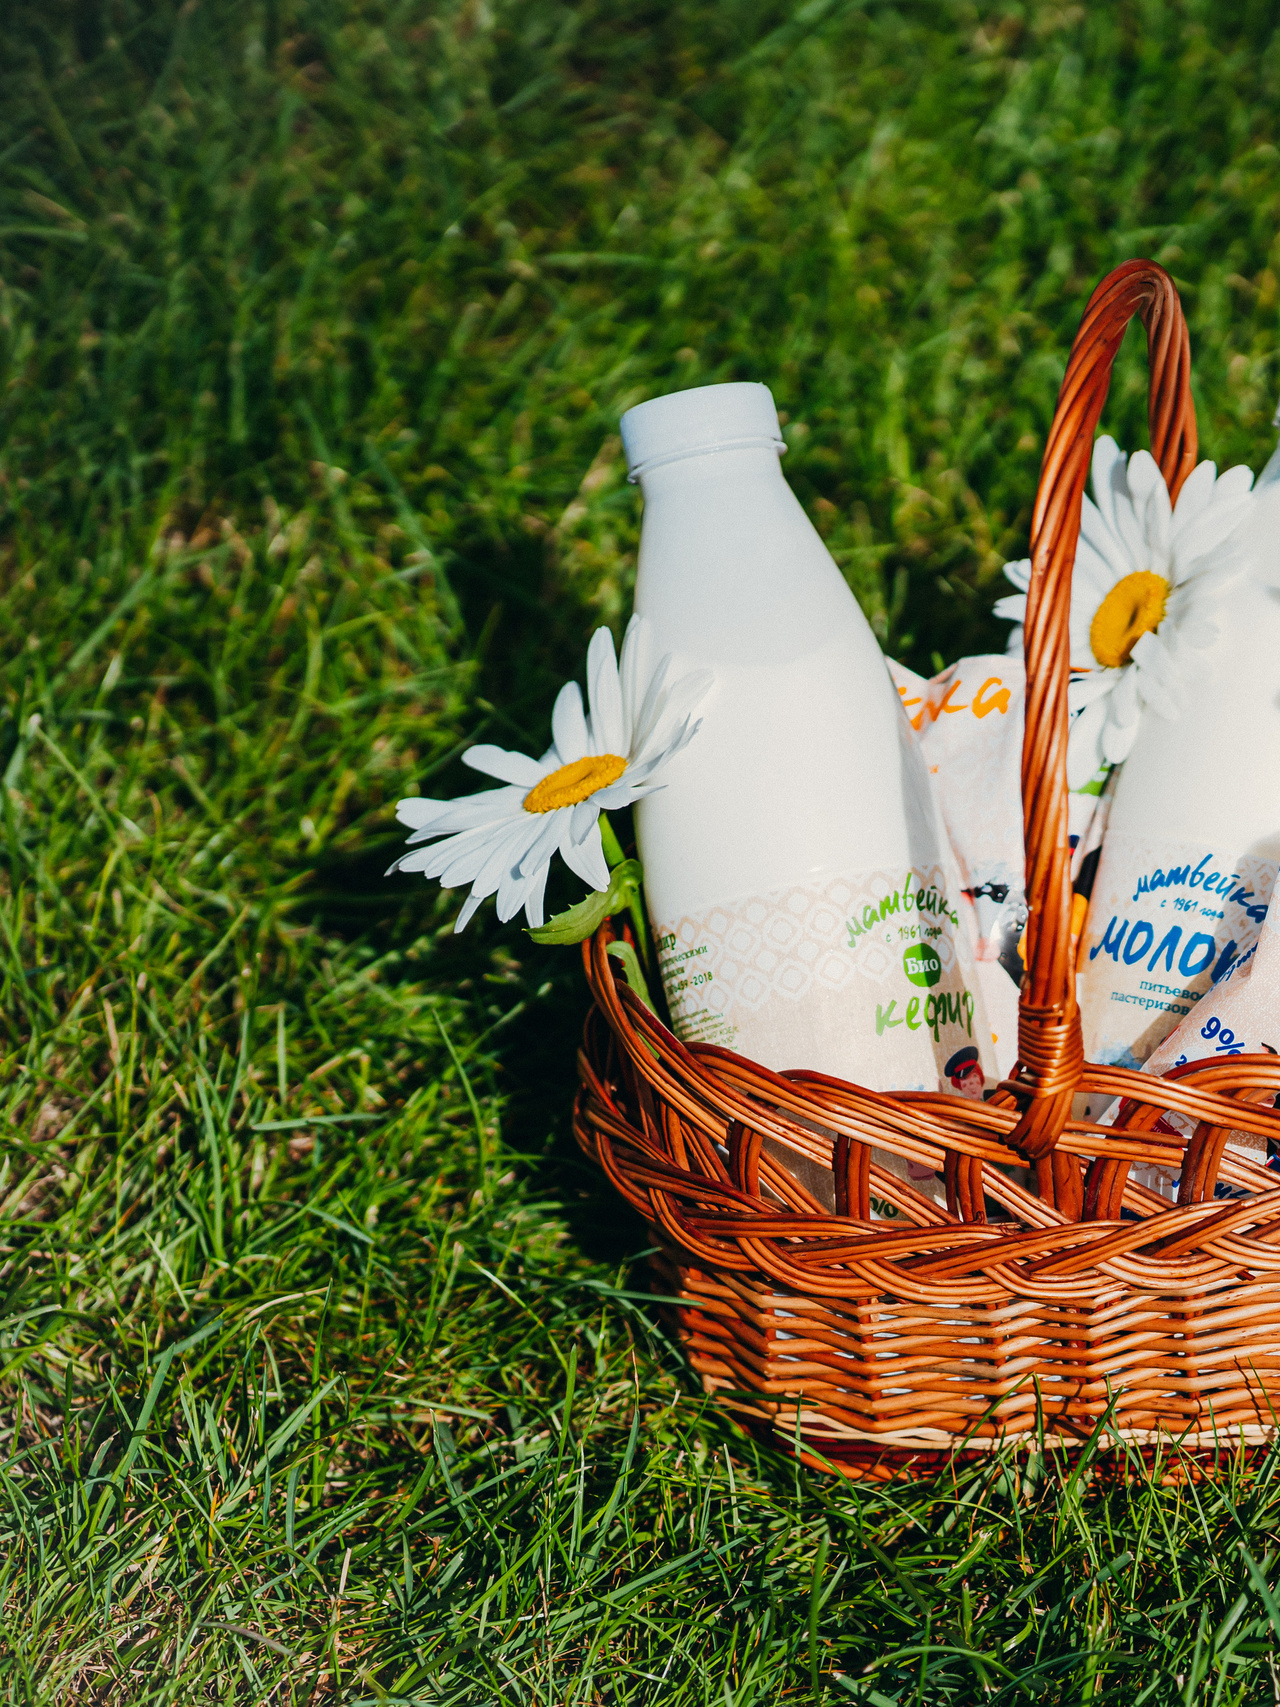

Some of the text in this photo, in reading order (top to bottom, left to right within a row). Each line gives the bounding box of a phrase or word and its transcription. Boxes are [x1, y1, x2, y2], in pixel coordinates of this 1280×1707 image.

[1132, 853, 1269, 924] матвейка
[845, 872, 959, 949] матвейка
[1173, 897, 1199, 914] 1961
[1199, 907, 1225, 922] года
[897, 924, 921, 941] 1961
[904, 956, 940, 976] Био
[876, 986, 975, 1043] кефир
